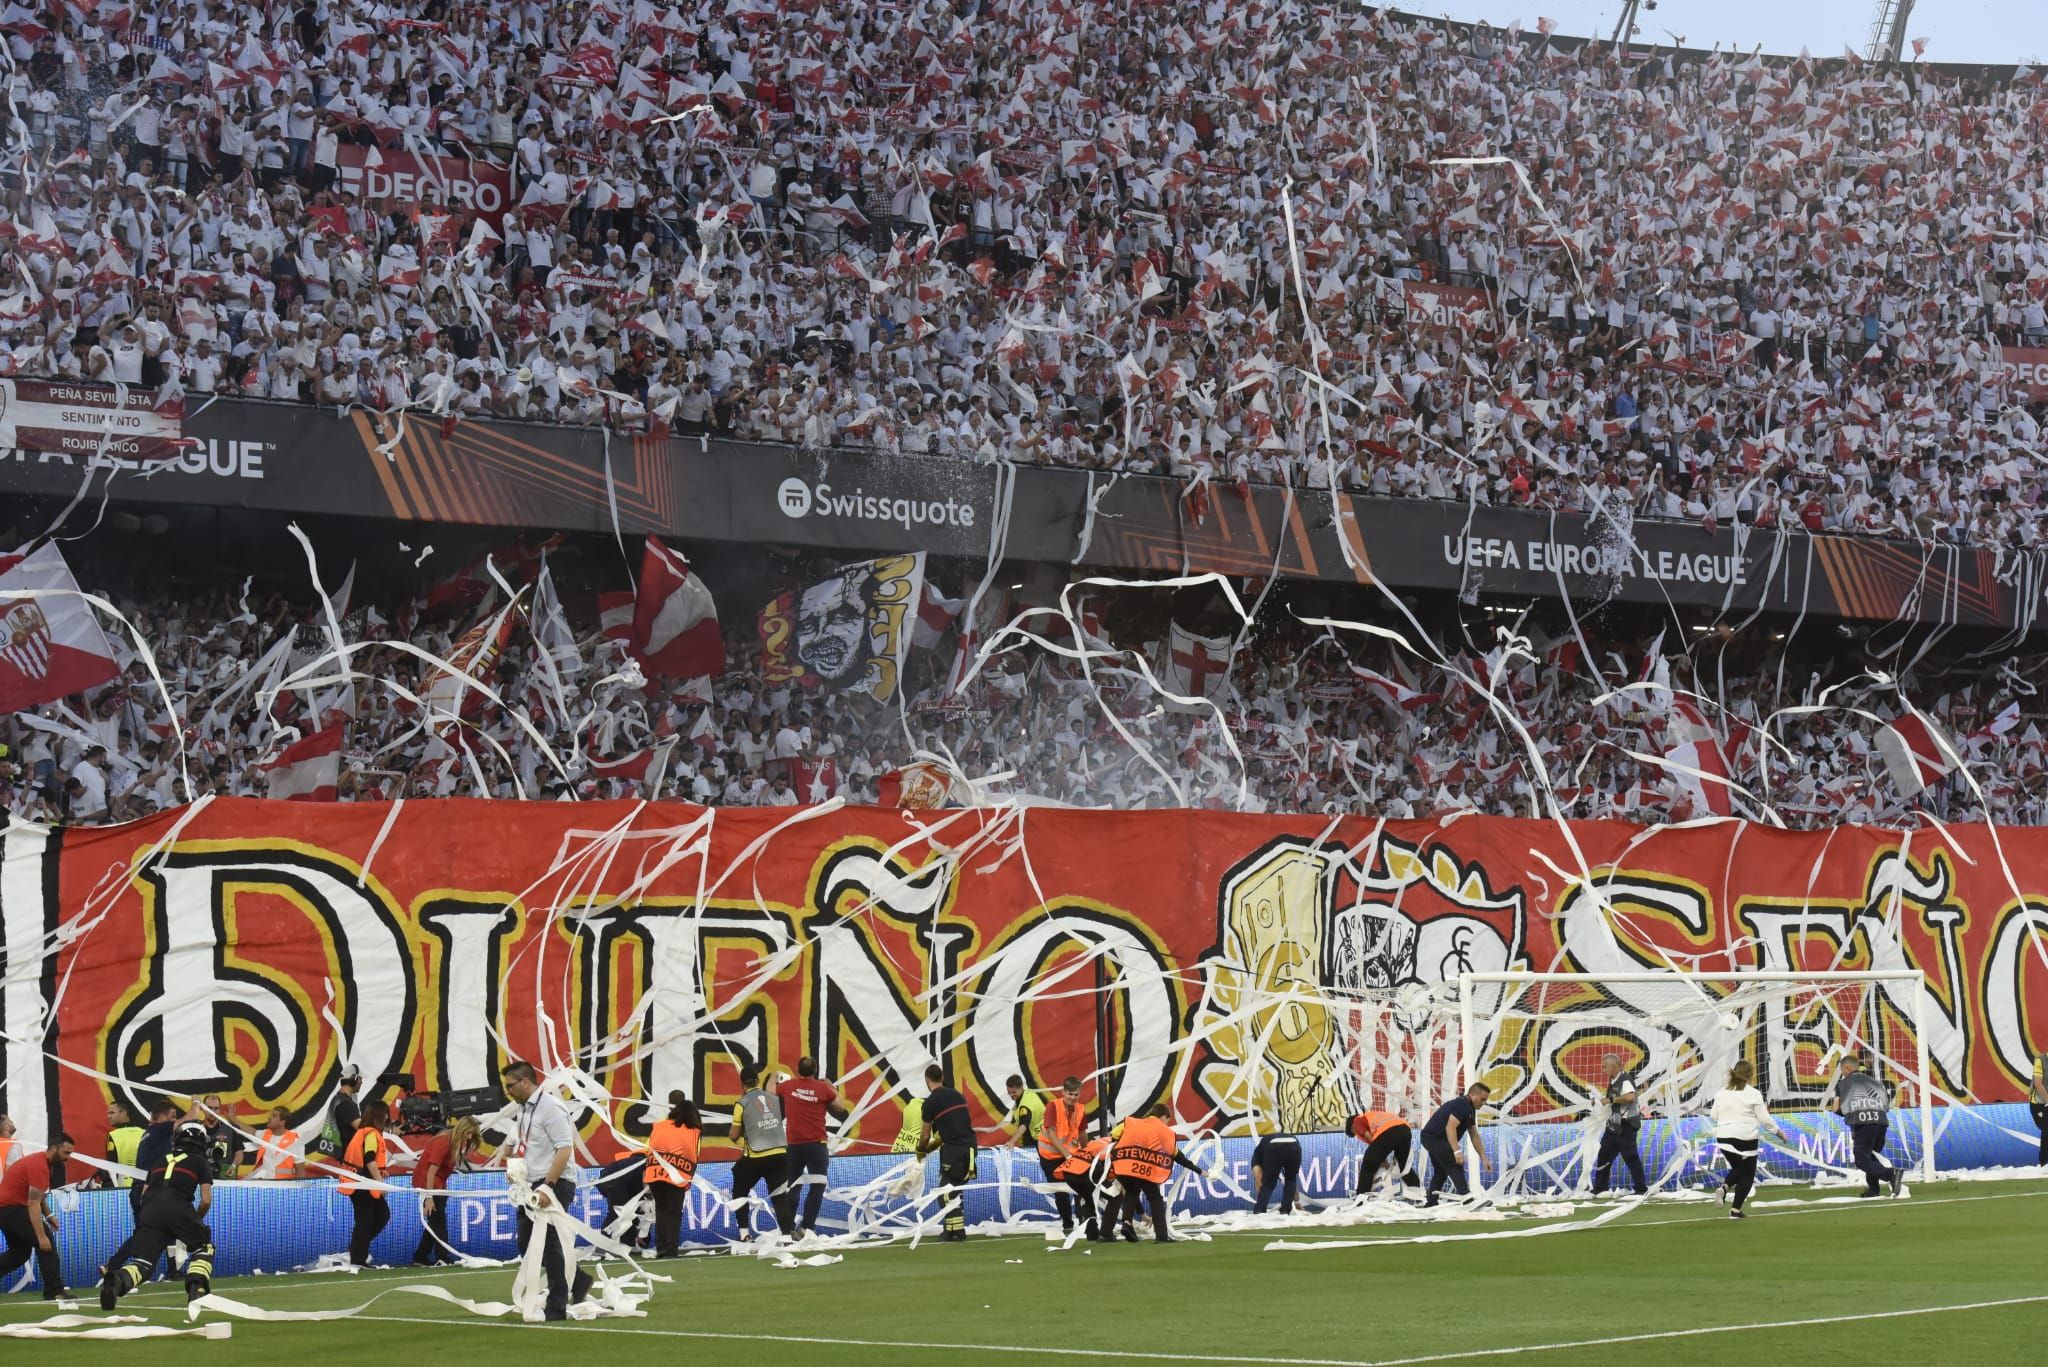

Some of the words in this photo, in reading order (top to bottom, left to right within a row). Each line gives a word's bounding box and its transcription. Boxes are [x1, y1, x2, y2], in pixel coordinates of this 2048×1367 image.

[367, 168, 501, 213] DEGIRO
[50, 387, 83, 400] PEÑA
[85, 390, 152, 406] SEVILISTA
[62, 411, 141, 428] SENTIMNTO
[62, 437, 140, 454] ROJIBANCO
[815, 483, 975, 531] Swissquote
[1443, 534, 1521, 570] UEFA
[1527, 541, 1637, 579] EUROPA
[1643, 549, 1748, 585] LEAGUE
[1849, 1099, 1887, 1112] PITCH
[1858, 1111, 1880, 1123] 013
[319, 1139, 335, 1153] 03
[1116, 1148, 1173, 1167] STEWARD
[1131, 1162, 1153, 1178] 286
[1160, 1160, 1251, 1202] EACE
